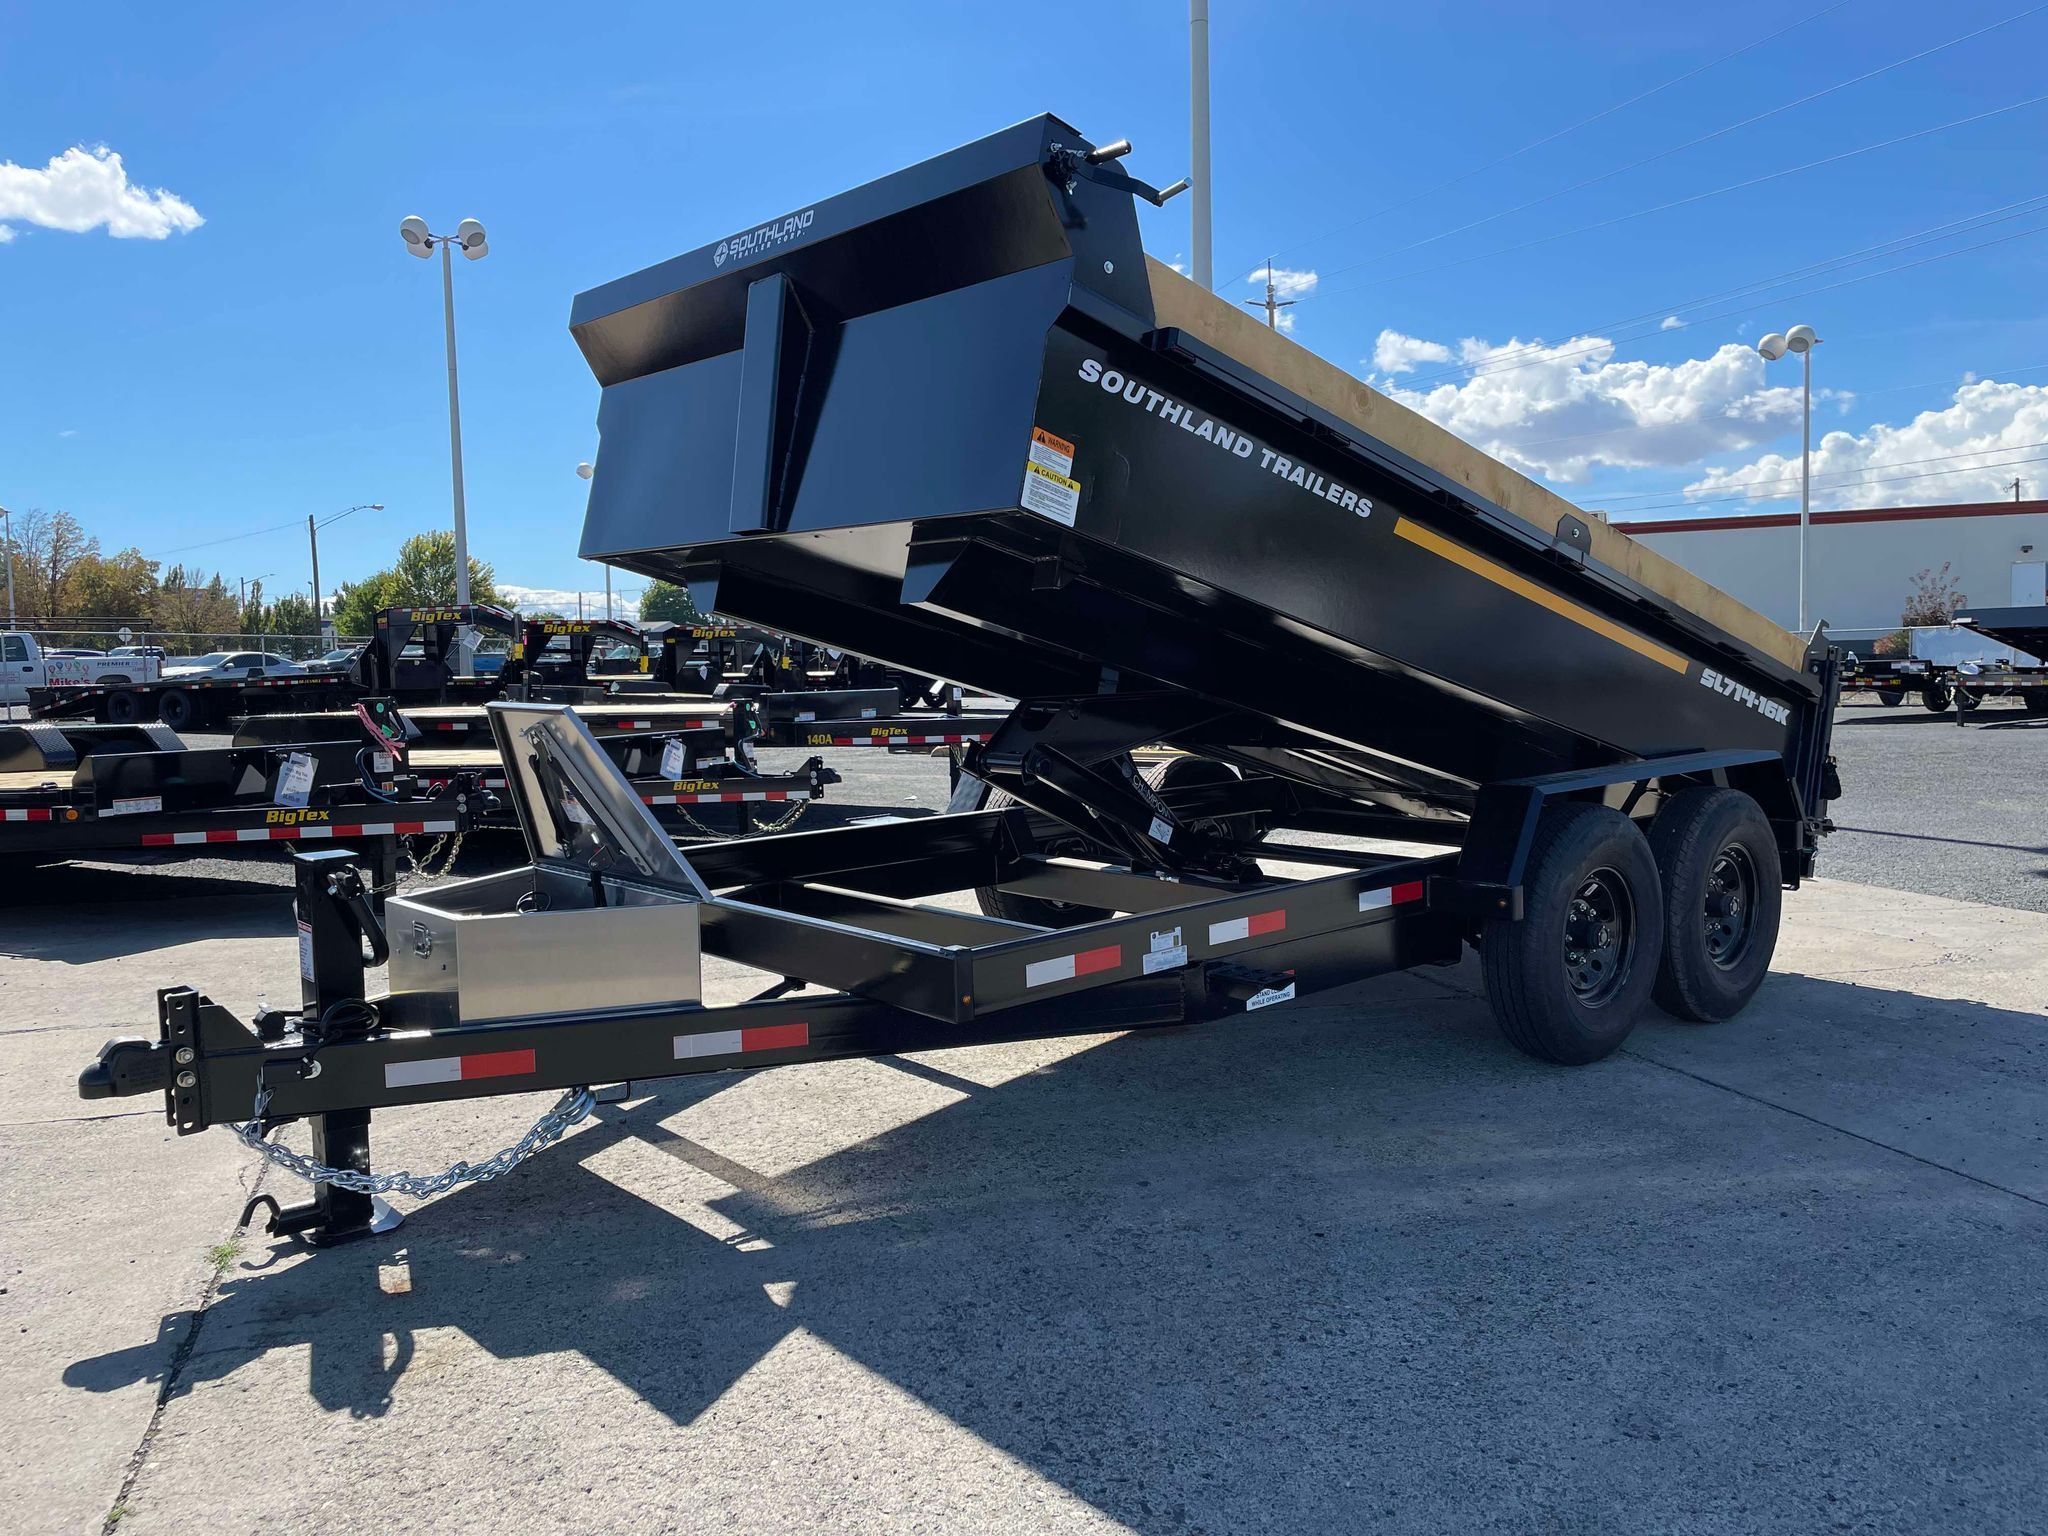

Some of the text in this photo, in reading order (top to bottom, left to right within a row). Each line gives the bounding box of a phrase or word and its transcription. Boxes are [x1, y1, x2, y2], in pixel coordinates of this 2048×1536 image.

[729, 209, 814, 255] SOUTHLAND
[733, 229, 806, 260] TRAILER CORP.
[1047, 437, 1070, 454] WARNING
[1078, 358, 1374, 518] SOUTHLAND TRAILERS
[1041, 469, 1068, 486] CAUTION
[410, 611, 462, 623] BigTex
[543, 624, 591, 635] BigTex
[692, 629, 737, 640] BigTex
[1700, 667, 1791, 726] SL714-16K
[806, 734, 833, 745] 140A
[871, 727, 908, 737] BigTex
[672, 781, 719, 793] BigTex
[266, 809, 330, 825] BigTex
[1251, 998, 1266, 1007] WHILE
[1265, 991, 1291, 1003] OPERATING
